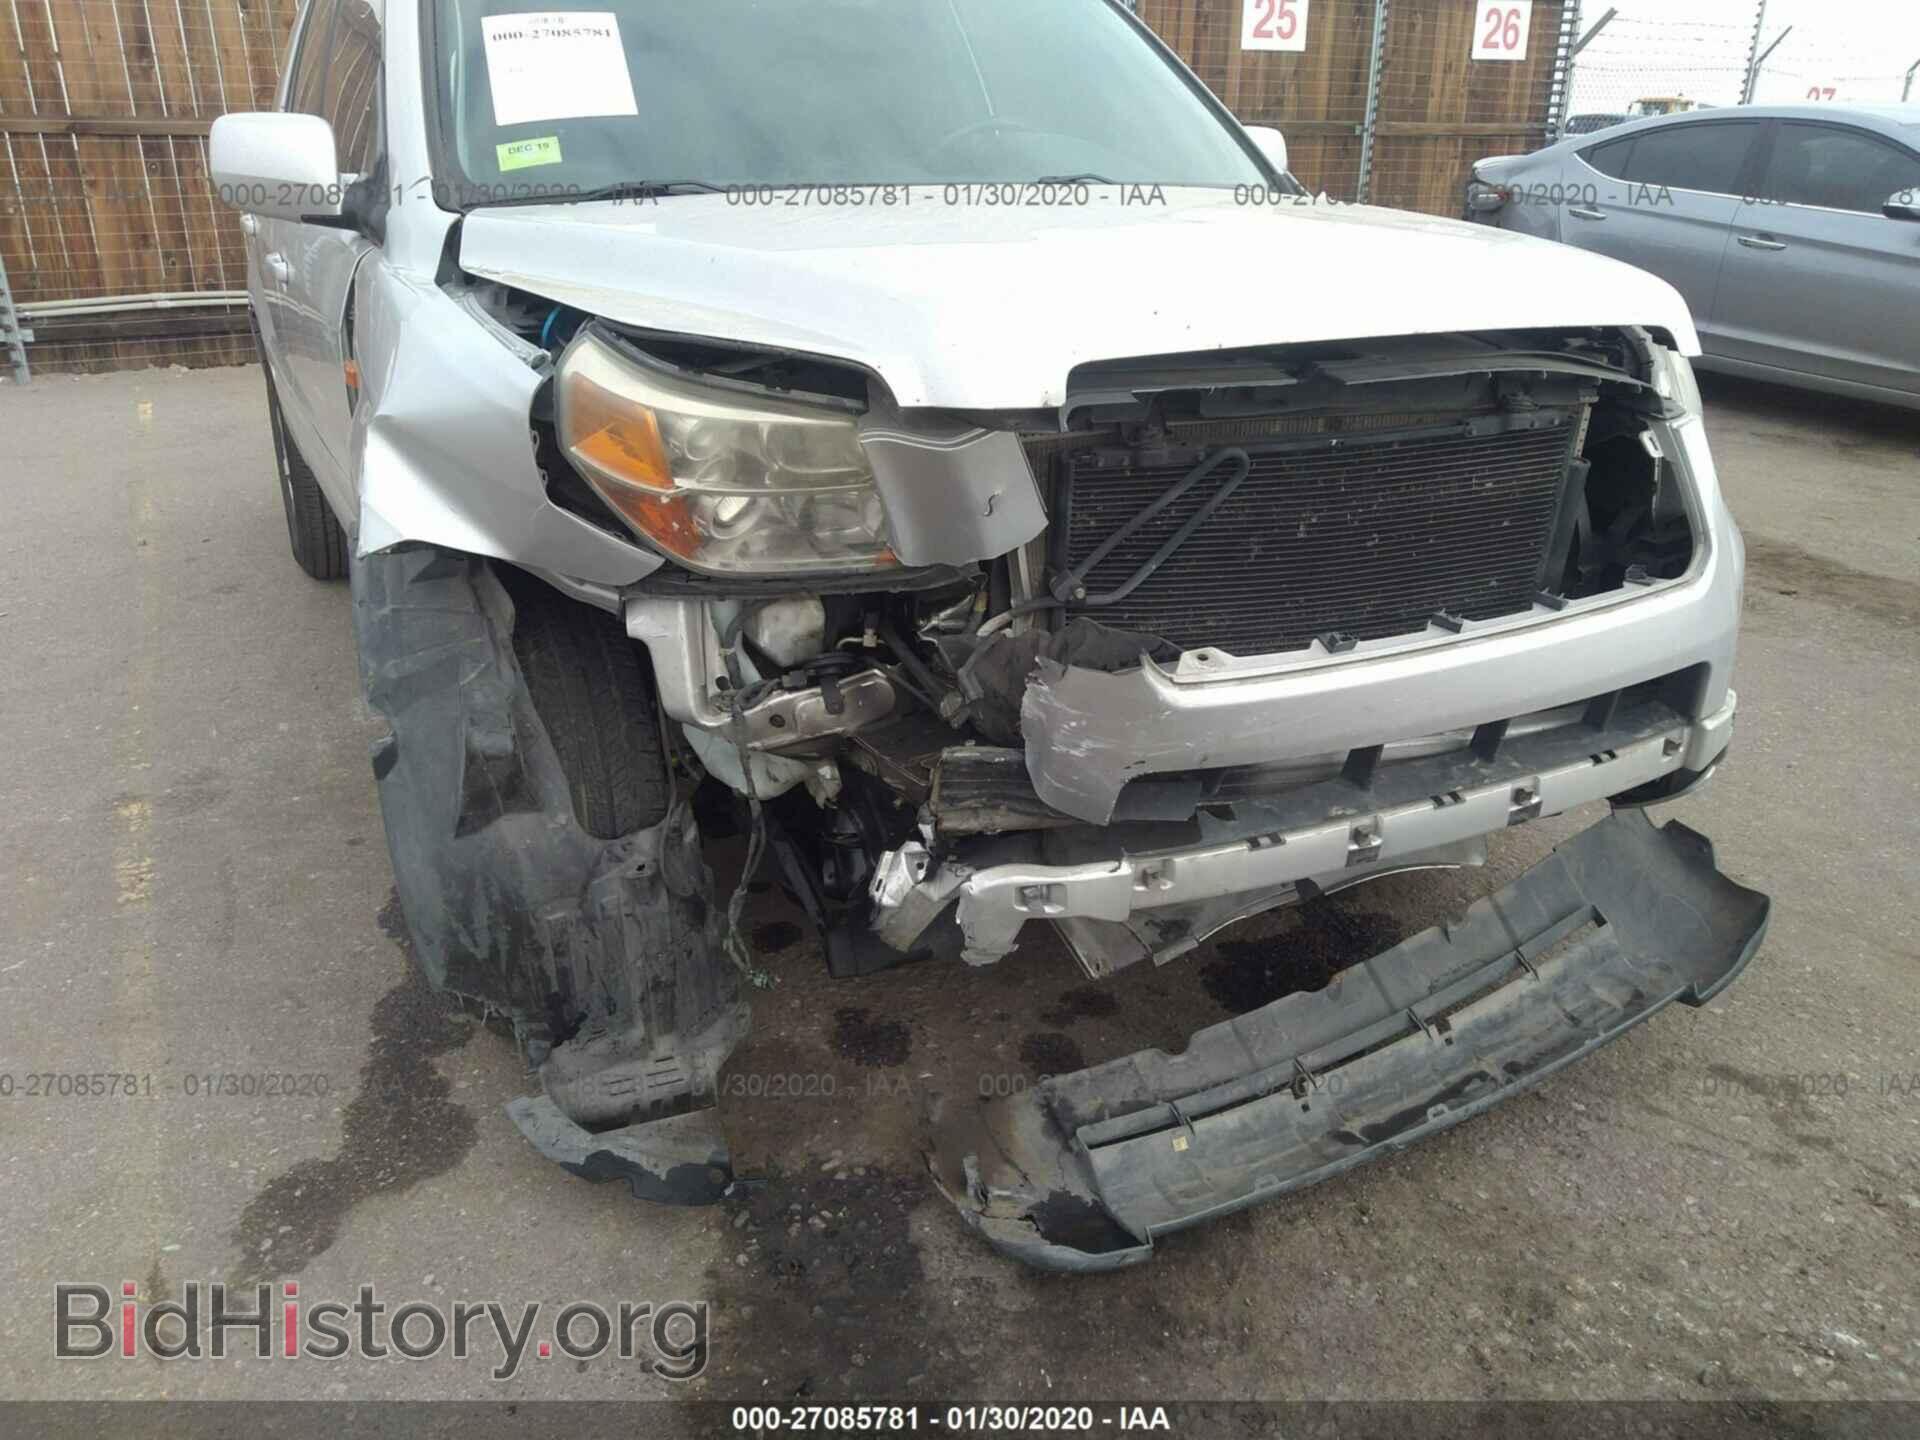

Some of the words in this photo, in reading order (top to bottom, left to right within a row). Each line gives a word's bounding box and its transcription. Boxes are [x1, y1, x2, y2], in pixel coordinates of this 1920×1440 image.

[1252, 0, 1298, 40] 25
[1482, 7, 1521, 51] 26
[508, 144, 534, 155] DEC
